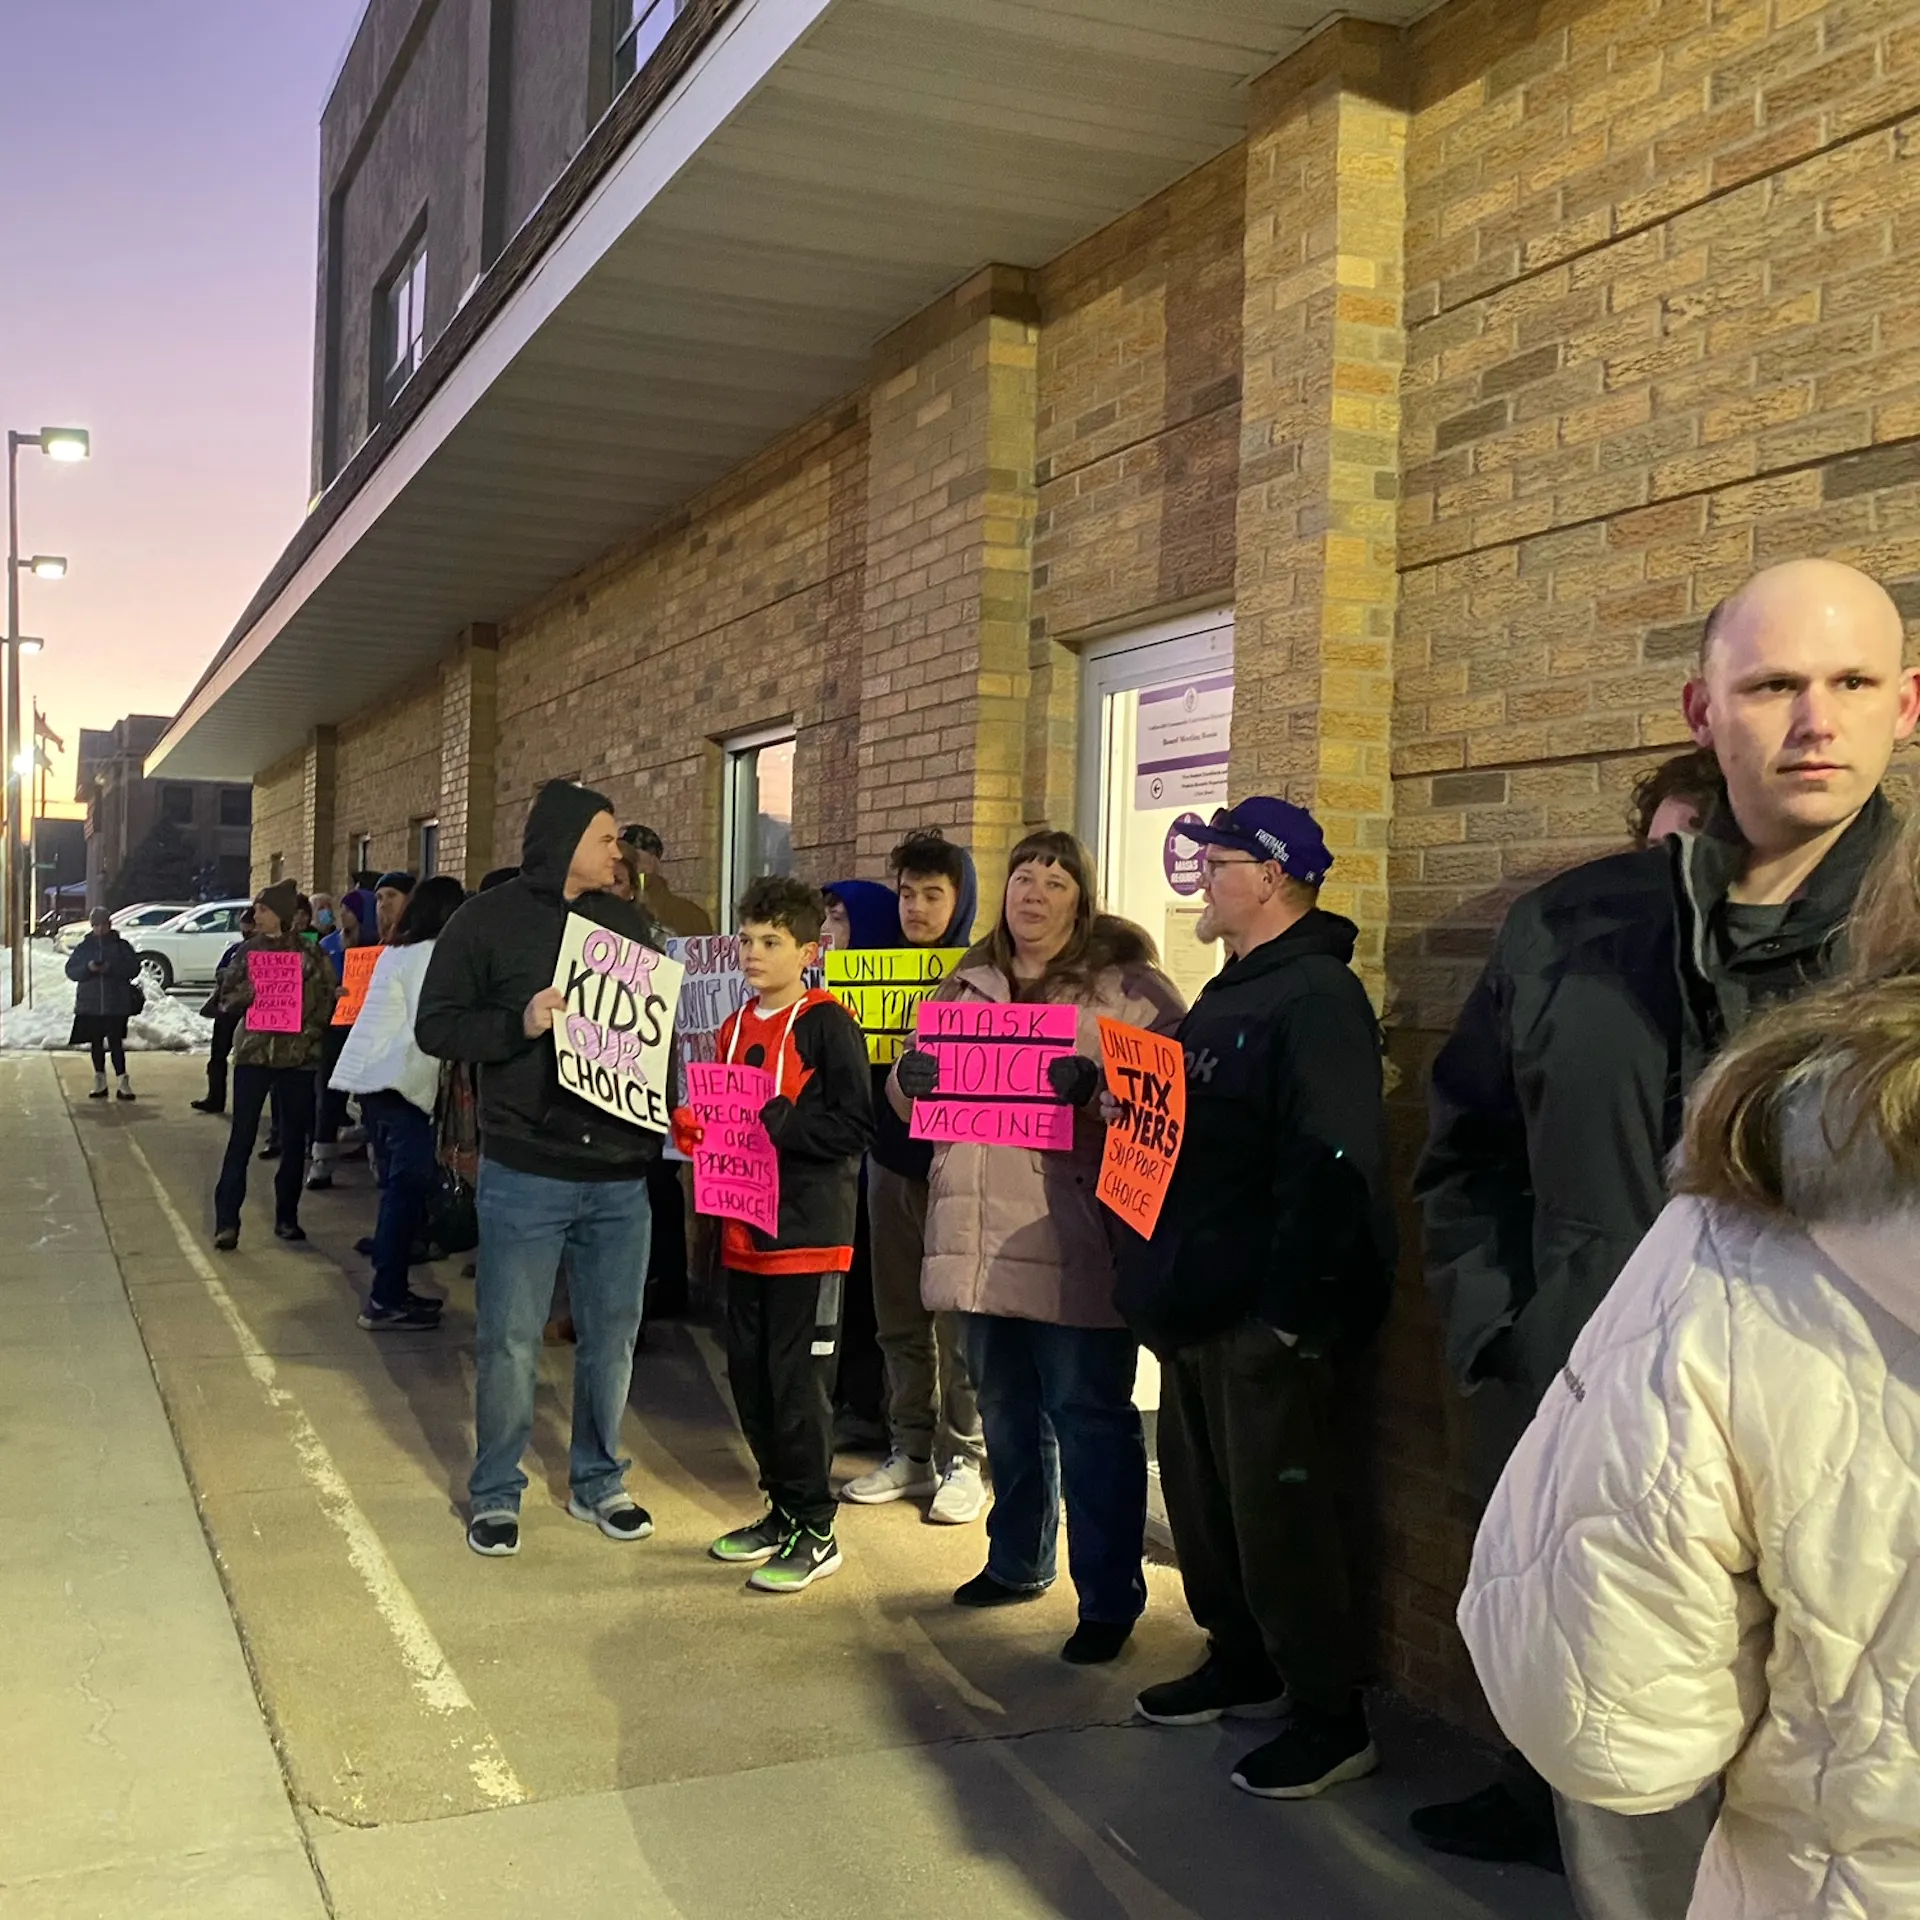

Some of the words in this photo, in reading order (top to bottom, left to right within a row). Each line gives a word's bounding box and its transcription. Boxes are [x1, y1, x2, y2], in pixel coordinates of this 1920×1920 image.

[583, 929, 660, 997] OUR
[685, 935, 742, 976] SUPPO
[843, 954, 903, 980] UNIT
[257, 982, 296, 995] UPPORT
[563, 959, 669, 1047] KIDS
[677, 979, 721, 1030] UNIT
[248, 1011, 291, 1027] KIDS
[937, 1008, 1049, 1039] MASK
[565, 1012, 648, 1085] OUR
[1100, 1023, 1144, 1066] UNIT
[558, 1050, 672, 1128] CHOICE
[691, 1067, 776, 1100] HEALTH
[1116, 1067, 1173, 1118] TAX
[693, 1102, 760, 1126] PRECAU
[916, 1105, 1057, 1140] VACCINE
[696, 1150, 774, 1189] PARENTS
[1108, 1137, 1173, 1186] SUPPORT
[701, 1185, 777, 1225] CHOICE!!
[1103, 1170, 1153, 1218] CHOICE
